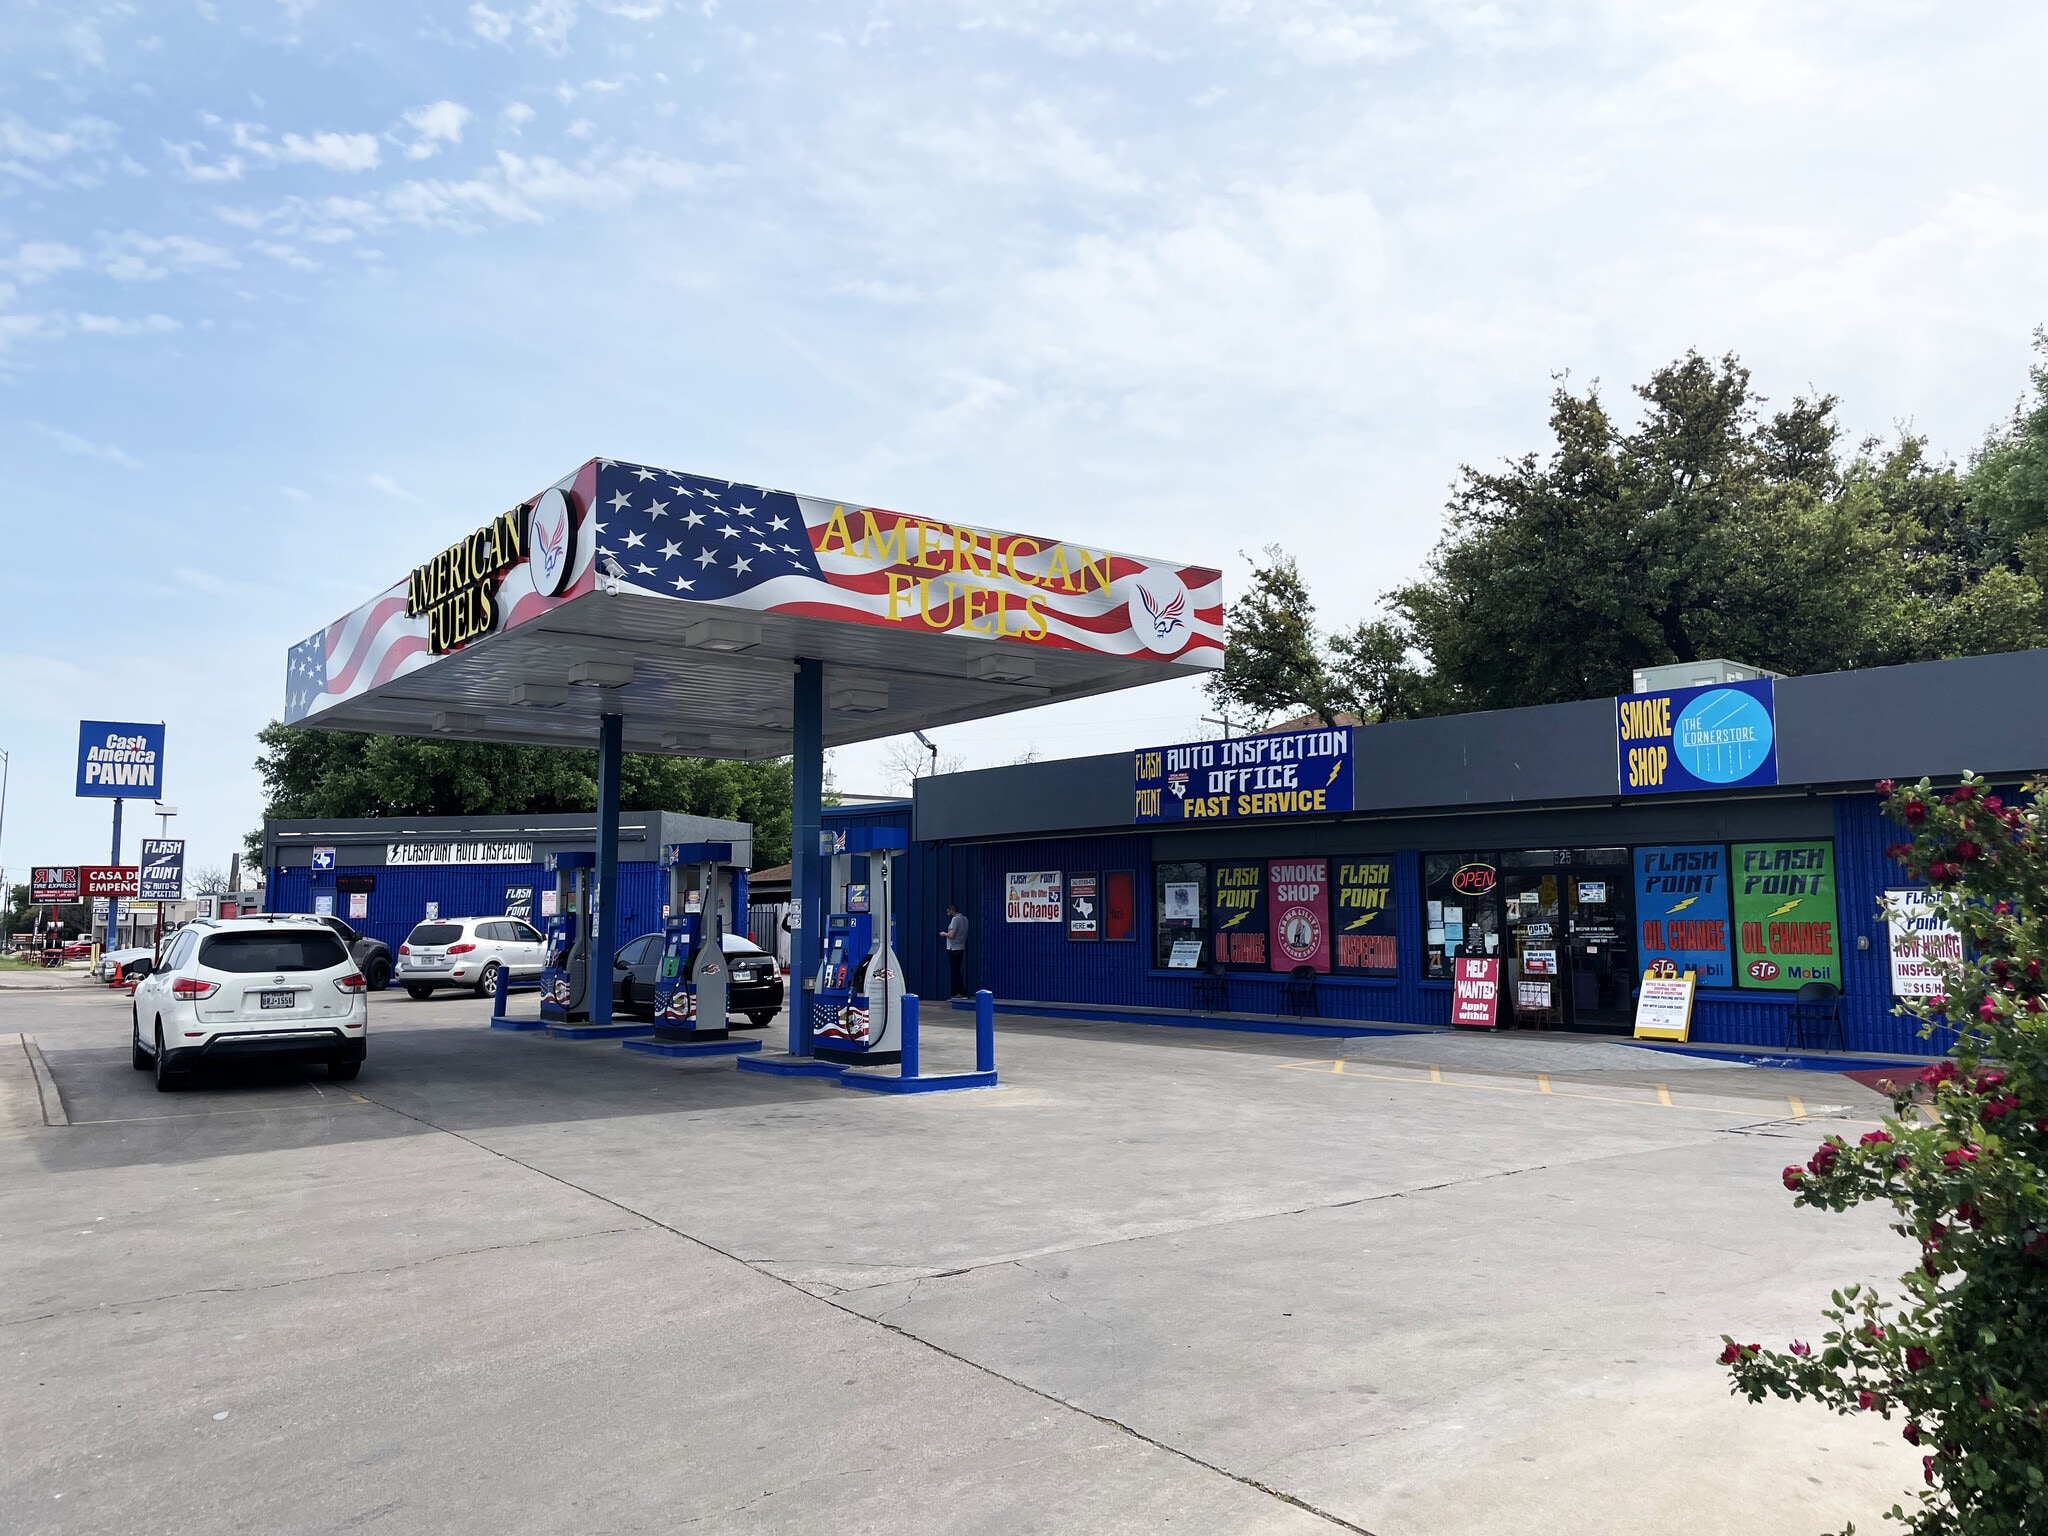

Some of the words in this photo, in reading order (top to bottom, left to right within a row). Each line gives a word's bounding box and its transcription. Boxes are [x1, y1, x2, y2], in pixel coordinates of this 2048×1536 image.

[405, 504, 525, 618] AMERICAN
[815, 505, 1113, 598] AMERICAN
[884, 571, 1048, 641] FUELS
[426, 579, 493, 655] FUELS
[1620, 697, 1672, 740] SMOKE
[1684, 717, 1702, 731] THE
[106, 734, 147, 751] Cash
[1684, 726, 1755, 745] CORNERSTORE
[87, 746, 156, 763] America
[1166, 745, 1214, 773] AUTO
[1220, 730, 1348, 769] INSPECTION
[85, 762, 155, 786] PAWN
[1135, 751, 1162, 782] FLASH
[1628, 746, 1668, 787] SHOP
[1208, 764, 1299, 794] OFFICE
[1135, 788, 1162, 818] POINT
[1183, 795, 1231, 819] FAST
[1238, 789, 1327, 815] SERVICE
[144, 841, 182, 854] FLASH
[402, 843, 453, 863] FLASHPOINT
[456, 843, 478, 863] AUTO
[481, 842, 532, 862] INSPECTION
[1554, 852, 1572, 865] 525
[1644, 851, 1719, 873] FLASH
[1744, 849, 1825, 873] FLASH
[34, 868, 76, 883] RNR
[89, 871, 122, 880] CASA
[143, 866, 181, 880] POINT
[1010, 875, 1027, 885] FLASH
[1040, 873, 1057, 883] POINT
[1216, 867, 1259, 888] FLASH
[1271, 865, 1326, 883] SMOKE
[1340, 864, 1390, 886] FLASH
[1455, 870, 1495, 888] OPEN
[89, 880, 138, 892] EMPEÑO
[141, 890, 180, 898] INSPECTION
[505, 888, 532, 899] FLASH
[1277, 884, 1320, 902] SHOP
[1645, 874, 1719, 895] POINT
[1744, 873, 1826, 896] POINT
[1216, 889, 1260, 909] POINT
[1339, 888, 1390, 909] POINT
[505, 906, 531, 917] POINT
[1008, 902, 1020, 918] Oil
[1022, 902, 1060, 920] Change
[851, 918, 856, 927] 2
[1072, 922, 1087, 930] HERE
[1280, 909, 1297, 934] MAMA
[1297, 909, 1320, 935] LILLY'S
[1528, 924, 1549, 935] OPEN
[1643, 919, 1666, 951] OIL
[1667, 919, 1726, 951] CHANGE
[1741, 921, 1767, 954] OIL
[1768, 922, 1833, 955] CHANGE
[1215, 932, 1230, 963] OIL
[1230, 932, 1265, 964] CHANGE
[1283, 942, 1302, 958] SMOKE
[1303, 941, 1317, 957] SHOP
[1338, 934, 1397, 969] INSPECTION
[1466, 959, 1488, 979] HELP
[1652, 959, 1674, 974] STP
[1685, 963, 1724, 976] Mobil
[1751, 961, 1777, 978] STP
[1788, 966, 1830, 979] Mobil
[1457, 980, 1495, 1000] WANTED
[1458, 1011, 1490, 1021] within
[1461, 1001, 1489, 1012] Apply
